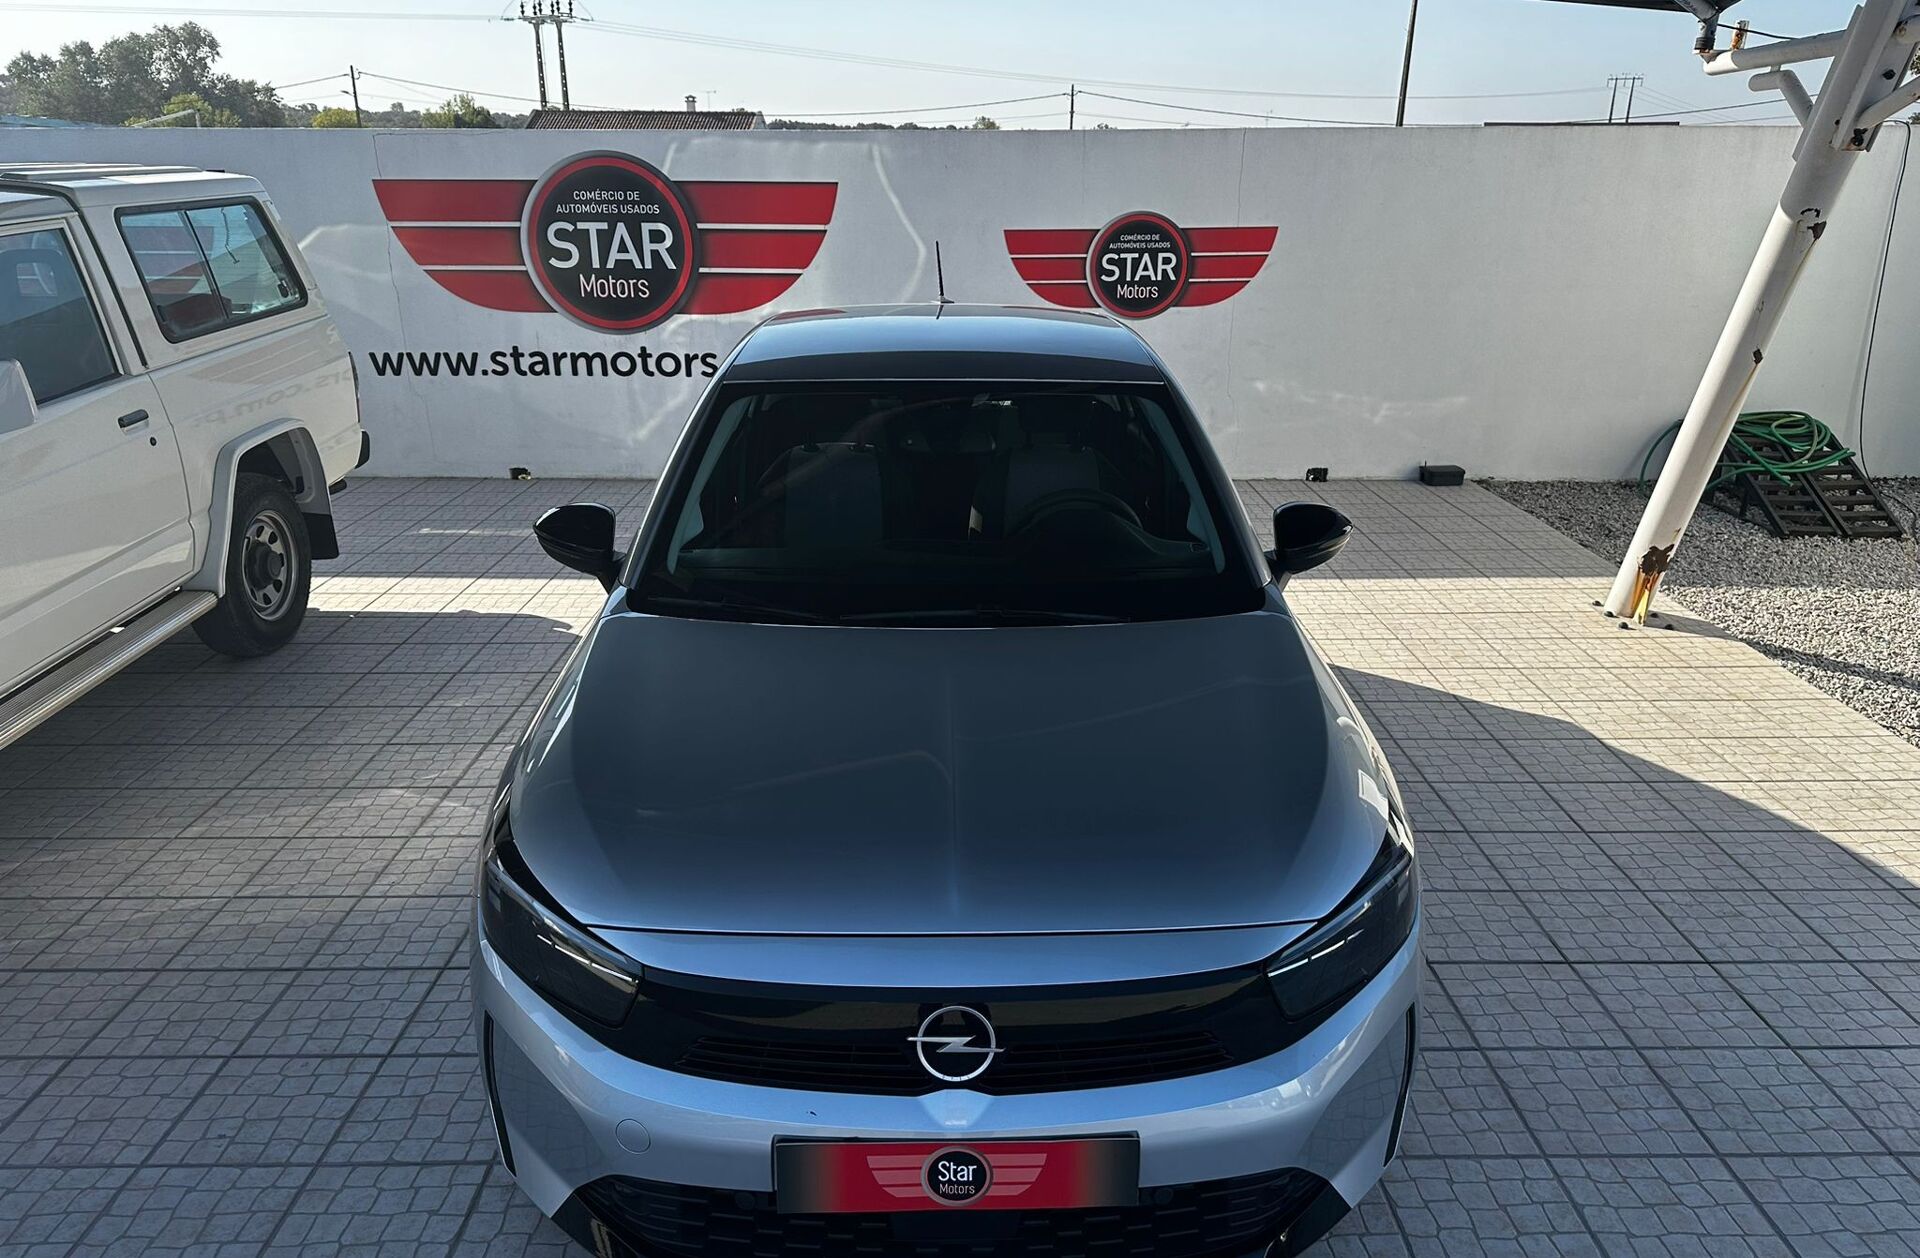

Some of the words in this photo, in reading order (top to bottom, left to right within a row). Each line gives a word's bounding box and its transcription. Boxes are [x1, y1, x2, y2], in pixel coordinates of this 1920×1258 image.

[573, 188, 625, 201] COMÉRCIO
[626, 190, 641, 201] DE
[556, 202, 619, 214] AUTOMÓVEIS
[620, 204, 660, 215] USADOS
[1109, 241, 1146, 249] AUTOMÓVEIS
[1120, 233, 1151, 241] COMÉRCIO
[546, 221, 677, 270] STAR
[1100, 252, 1177, 282] STAR
[579, 273, 650, 299] Motors
[1117, 283, 1159, 299] Motors
[368, 345, 719, 378] www.starmotors
[938, 1160, 977, 1182] Star
[939, 1183, 975, 1195] Motors
